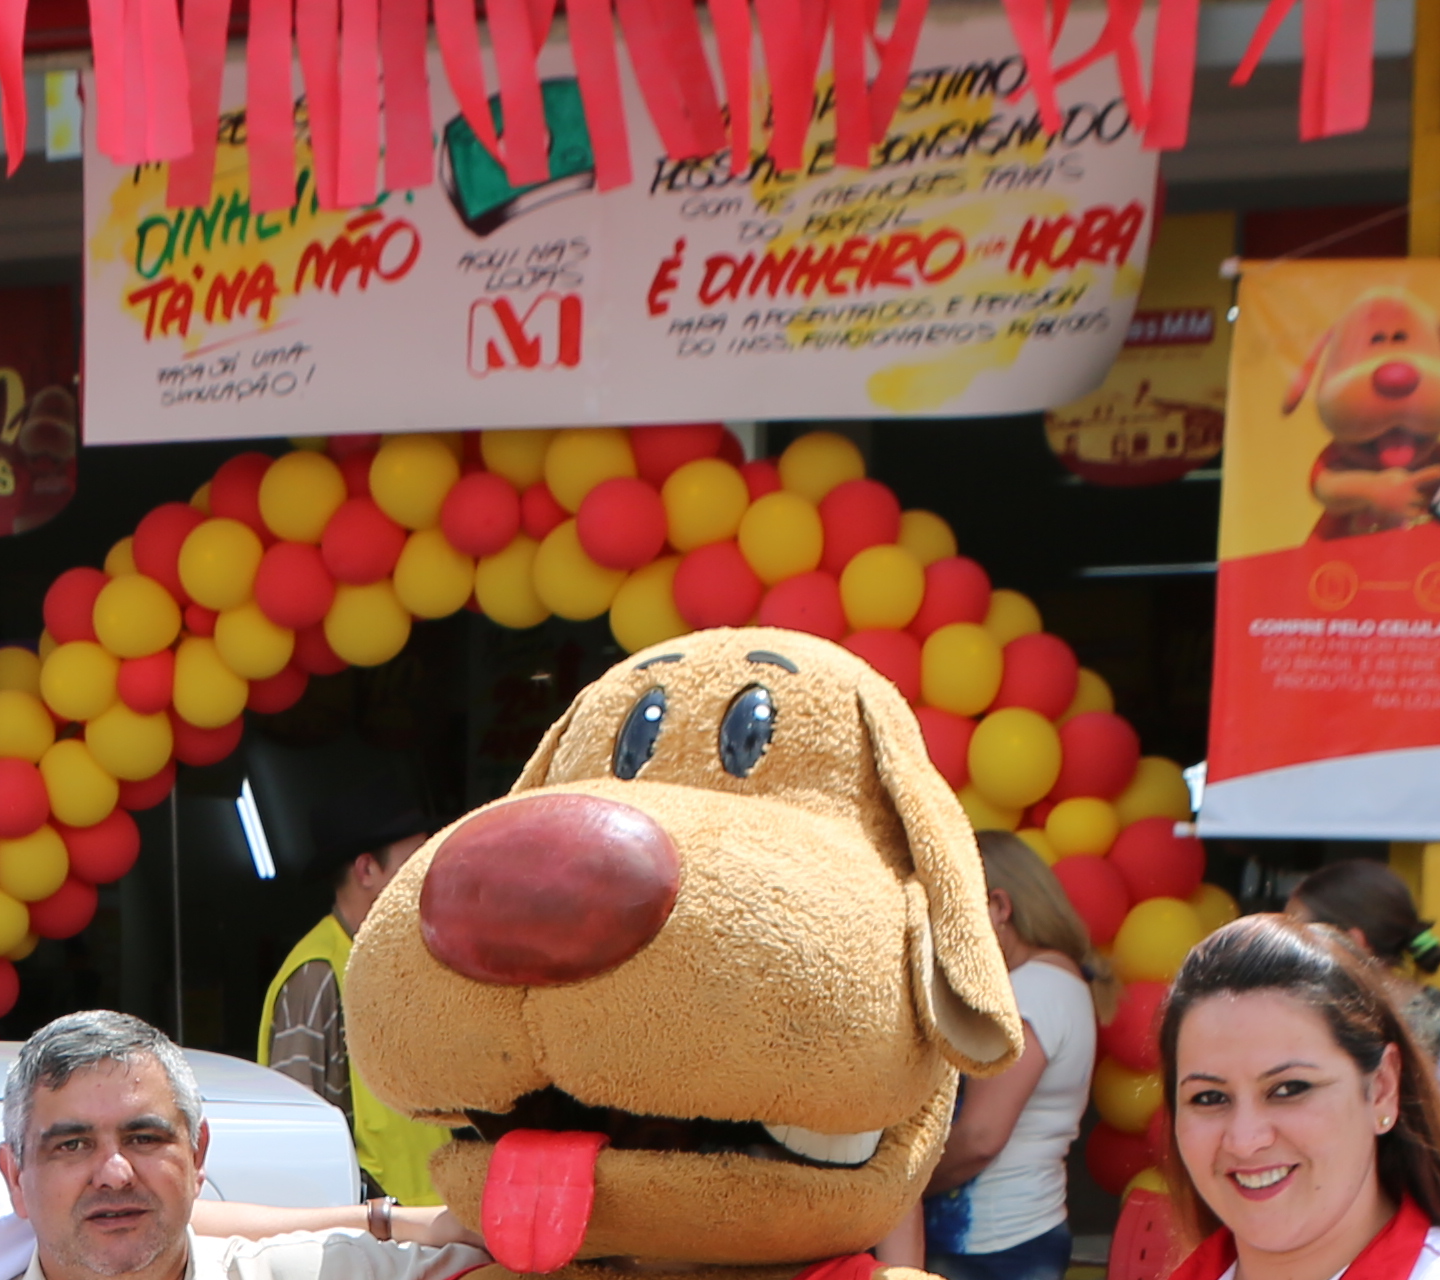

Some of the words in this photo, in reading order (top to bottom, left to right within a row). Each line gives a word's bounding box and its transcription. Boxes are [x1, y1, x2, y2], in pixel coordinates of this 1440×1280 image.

[696, 226, 969, 307] DINHEIRO
[1006, 198, 1147, 280] HORA
[1248, 618, 1326, 637] COMPRE
[1327, 618, 1376, 637] PELO
